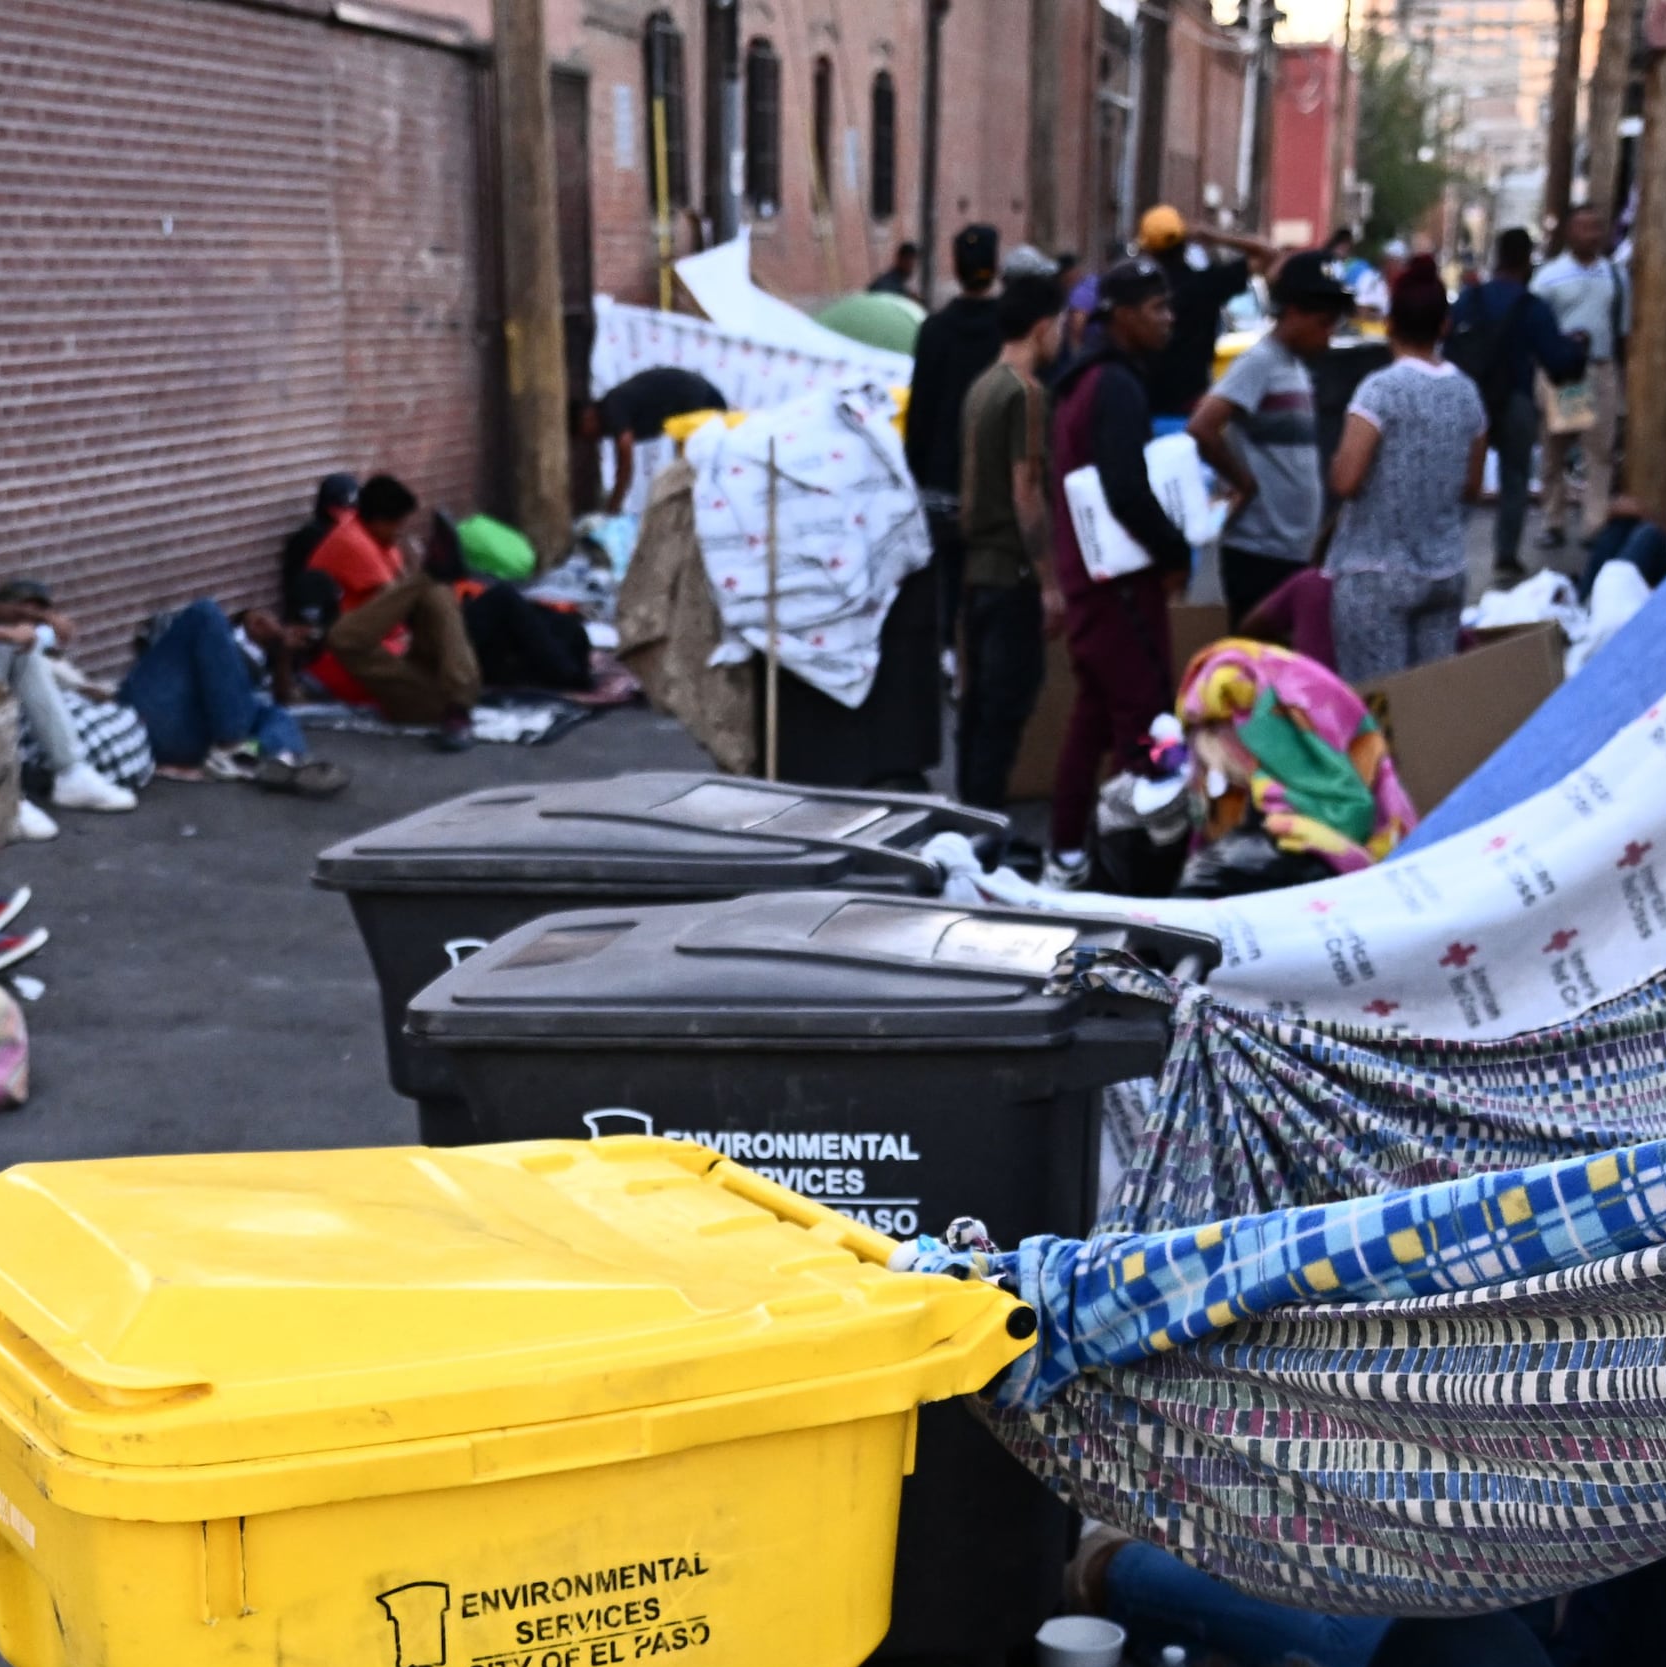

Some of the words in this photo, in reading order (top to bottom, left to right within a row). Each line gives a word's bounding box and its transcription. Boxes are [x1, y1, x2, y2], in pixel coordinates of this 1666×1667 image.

[749, 1167, 865, 1195] RVICES
[461, 1552, 709, 1618] ENVIRONMENTAL
[516, 1597, 661, 1644] SERVICES
[590, 1641, 625, 1667] EL
[634, 1622, 711, 1659] PASO
